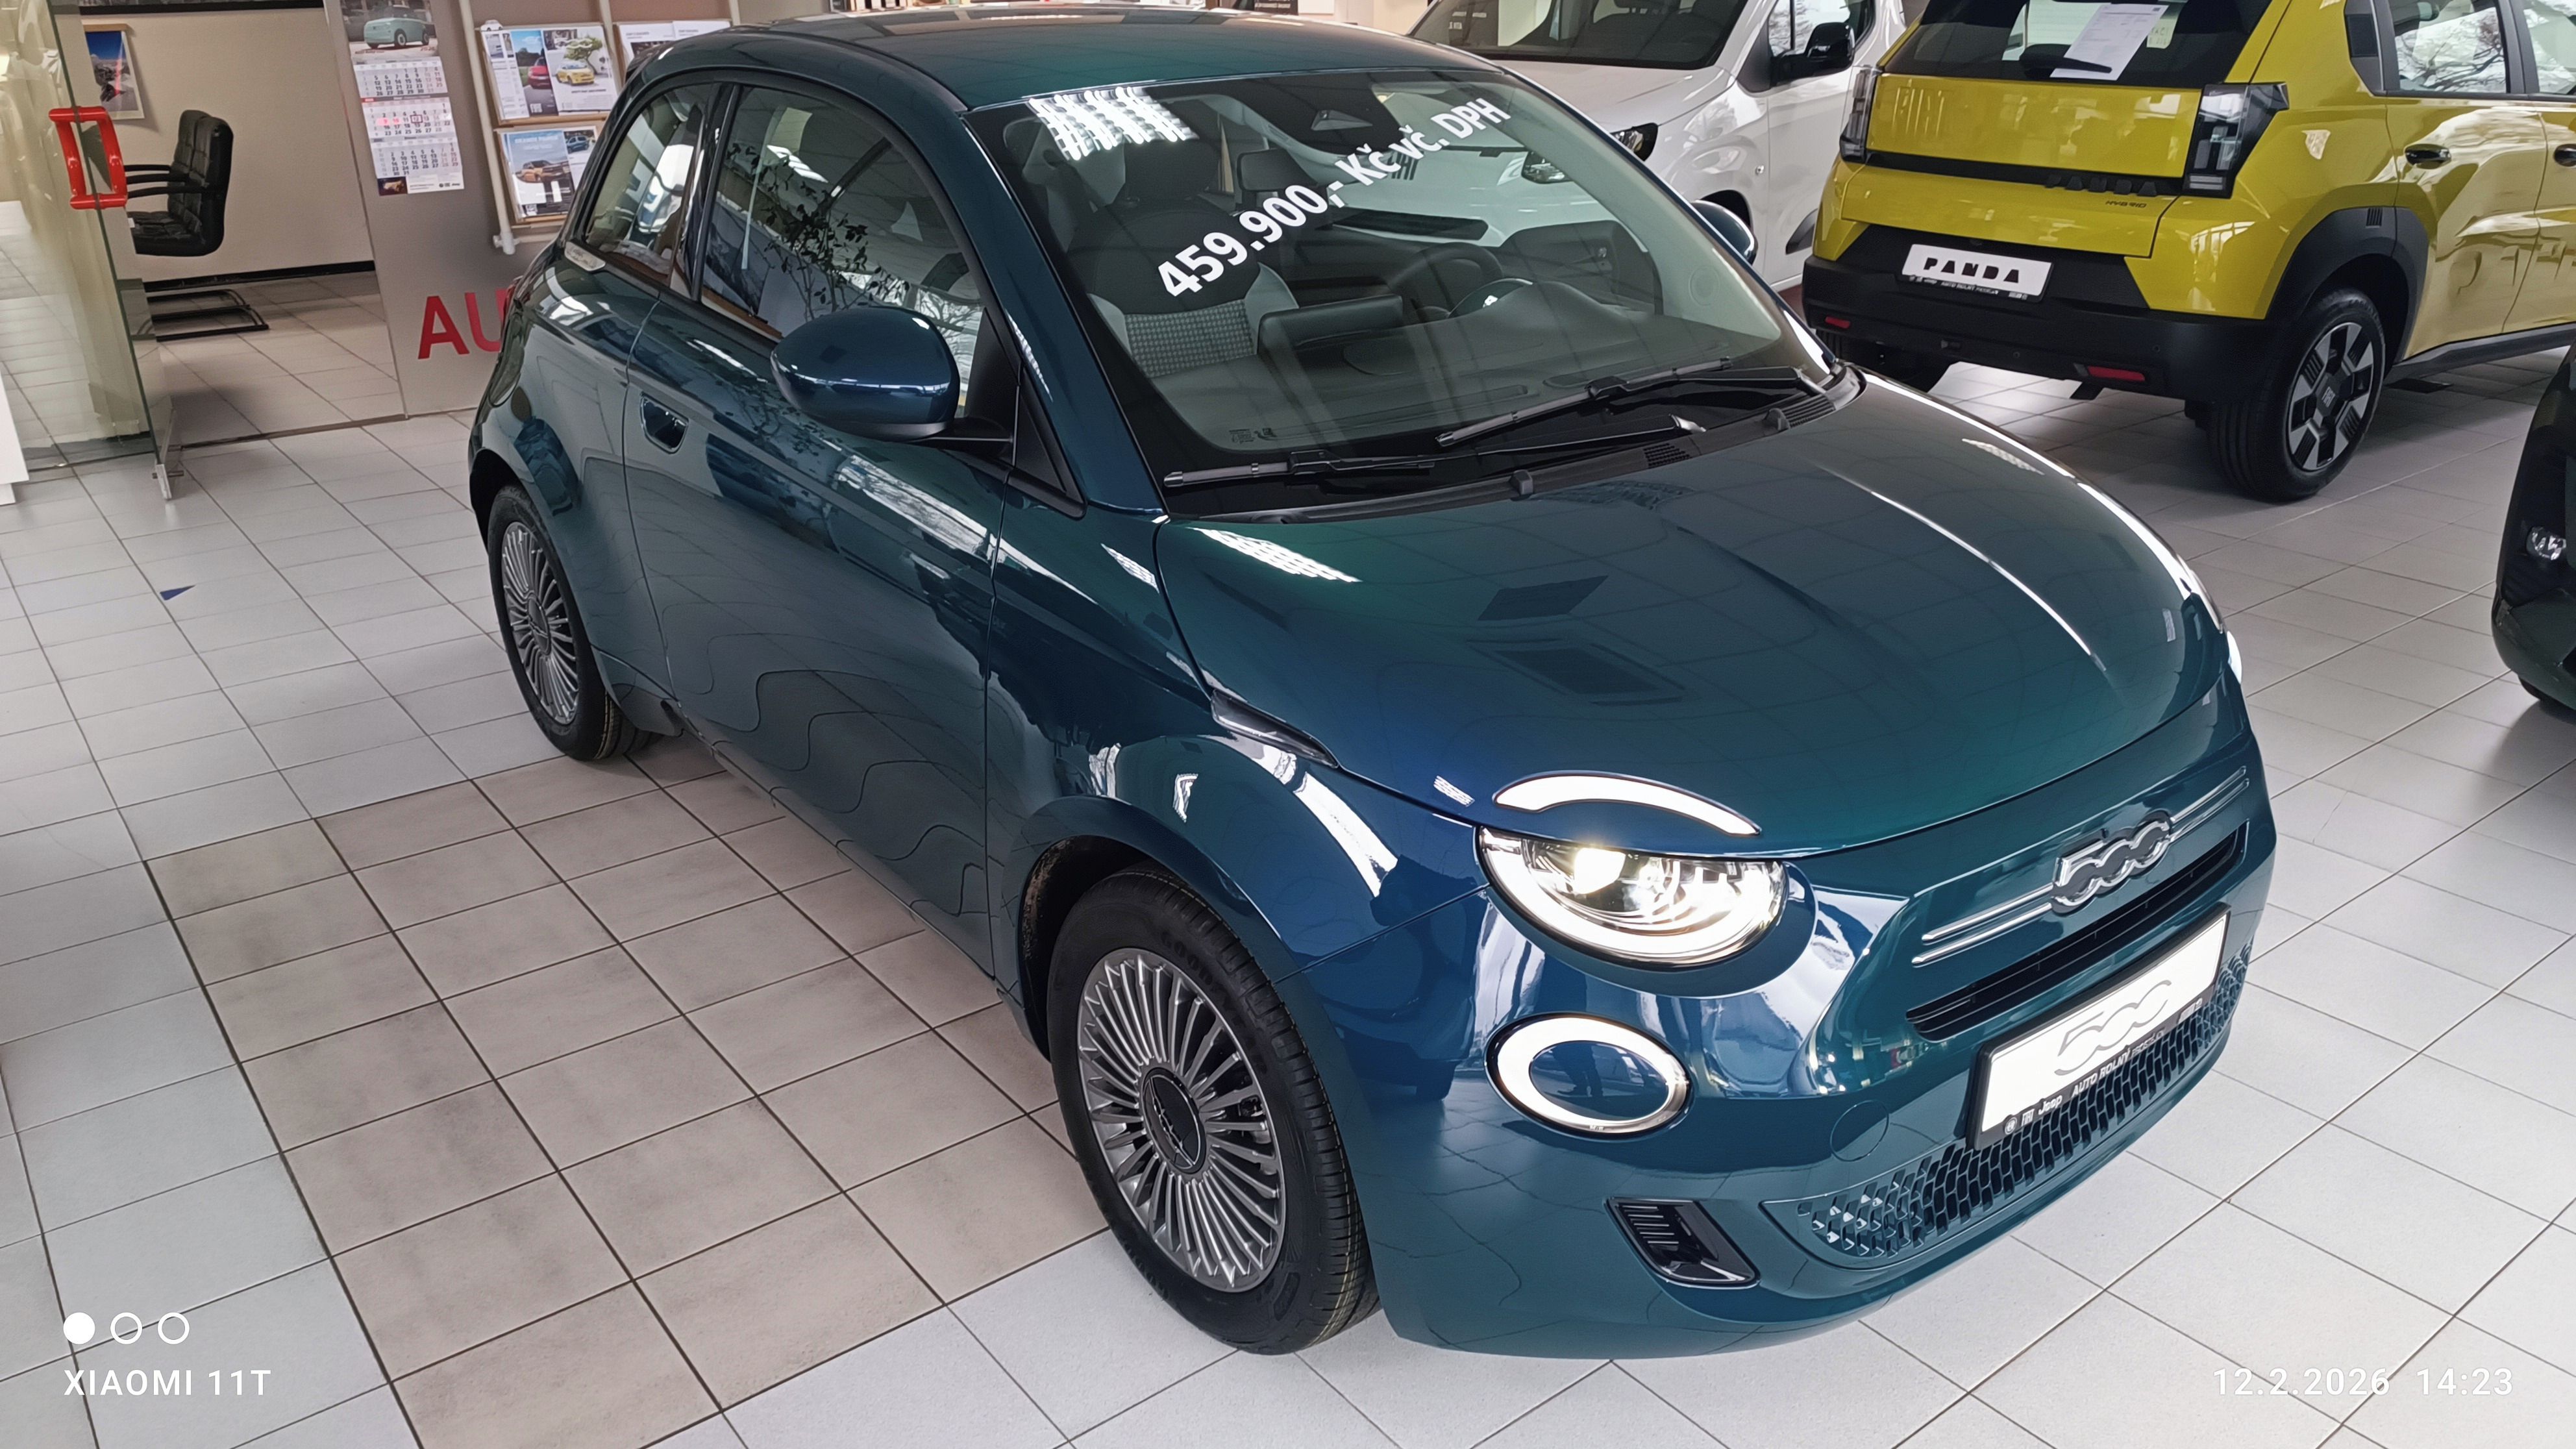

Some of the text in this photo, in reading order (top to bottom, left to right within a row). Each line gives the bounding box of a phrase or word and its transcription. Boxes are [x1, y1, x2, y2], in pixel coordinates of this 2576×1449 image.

[1158, 98, 1511, 297] 459.900,- Kč vč. DPH
[1924, 257, 2020, 284] PANDA
[2051, 821, 2170, 907] 500
[2054, 980, 2172, 1076] 500
[2021, 1109, 2035, 1126] FIAT
[2038, 1095, 2063, 1115] Jeep
[2071, 1072, 2098, 1098] AUTO
[2098, 1047, 2131, 1080] ROLNÝ
